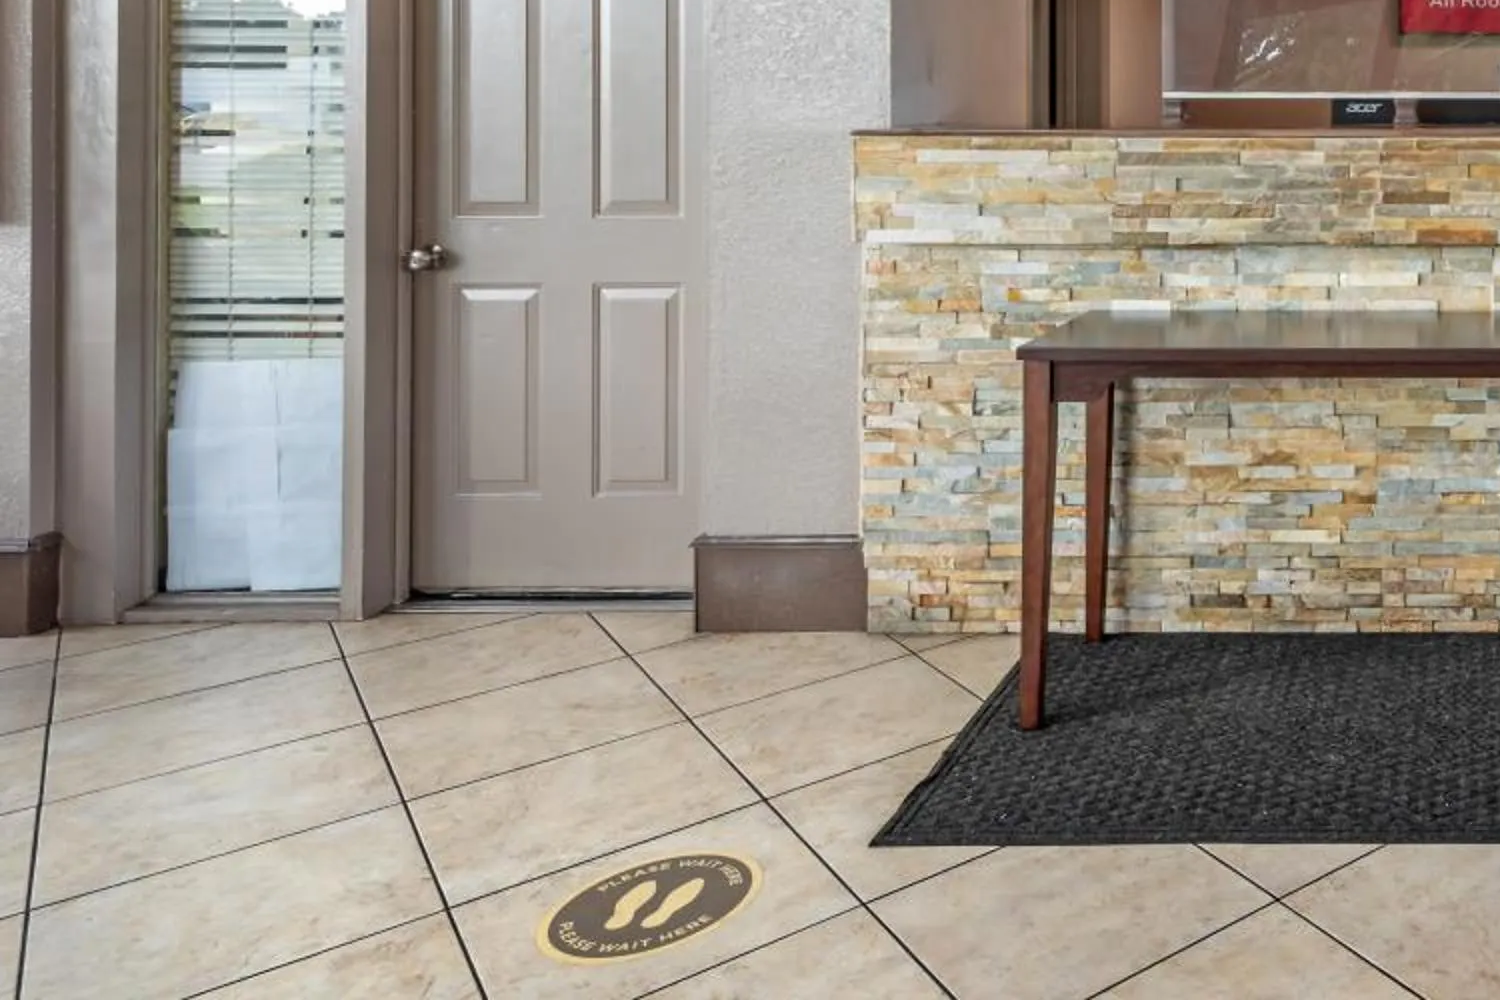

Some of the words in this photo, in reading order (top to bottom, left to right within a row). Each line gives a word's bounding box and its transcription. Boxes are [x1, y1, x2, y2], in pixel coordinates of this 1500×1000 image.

[1345, 103, 1383, 113] acer
[558, 920, 597, 951] PLEASE
[599, 937, 652, 952] WAIT
